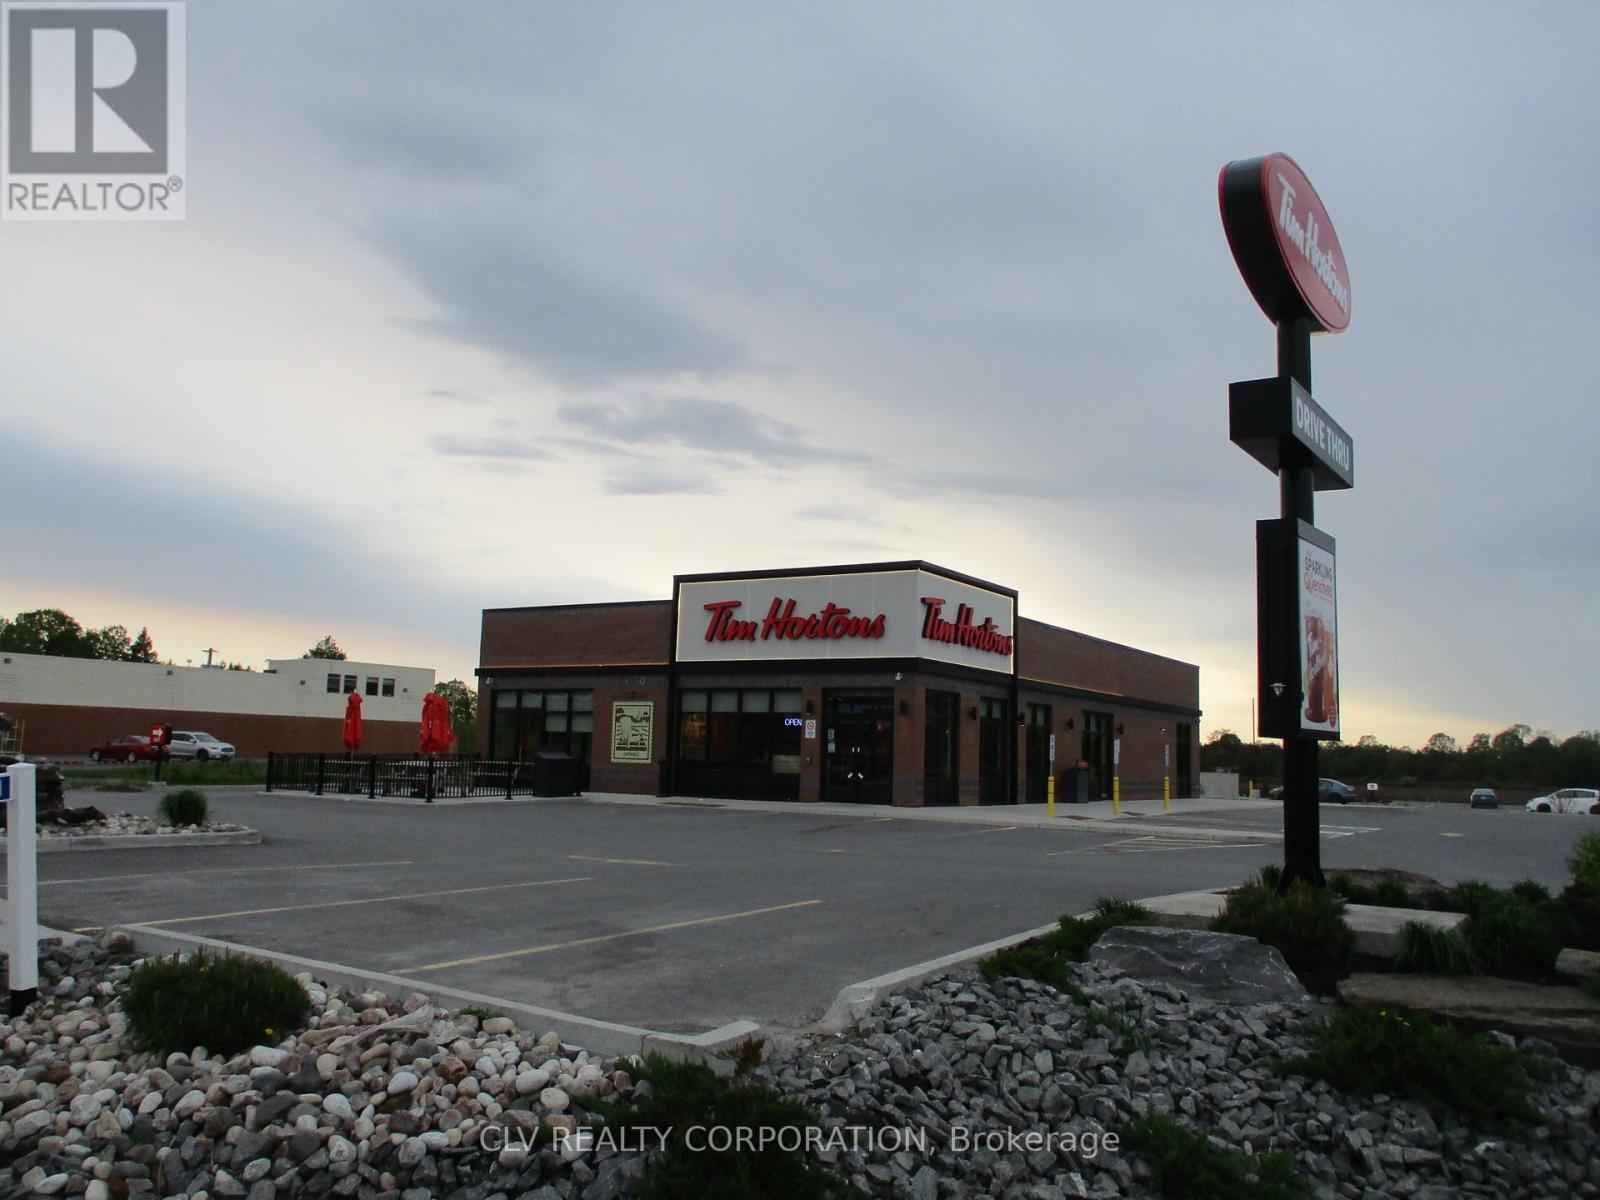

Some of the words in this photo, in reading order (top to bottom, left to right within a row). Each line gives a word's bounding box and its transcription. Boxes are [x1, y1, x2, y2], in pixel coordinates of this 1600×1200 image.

[1277, 172, 1305, 256] Tim
[1304, 211, 1347, 314] Hortons
[1296, 396, 1326, 450] DRIVE
[1326, 425, 1350, 472] THRU
[1304, 556, 1333, 582] SPARKLING
[703, 600, 758, 642] Tim
[760, 597, 886, 640] Hortons
[920, 597, 960, 645] Tim
[956, 603, 1013, 656] Hortons
[784, 718, 803, 726] OPEN
